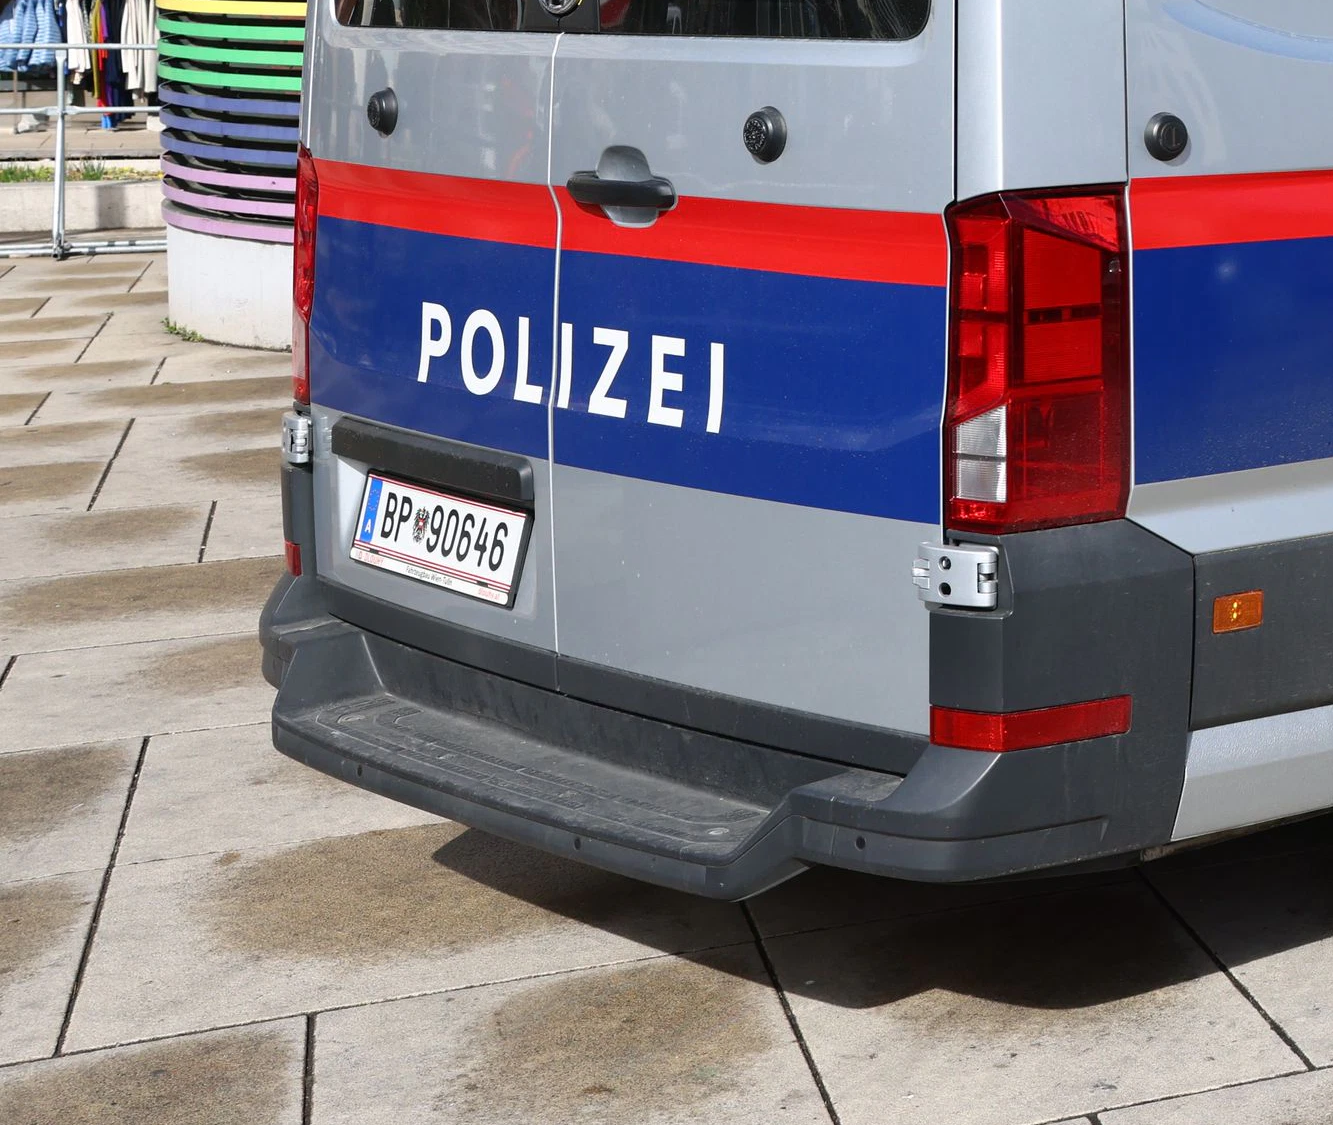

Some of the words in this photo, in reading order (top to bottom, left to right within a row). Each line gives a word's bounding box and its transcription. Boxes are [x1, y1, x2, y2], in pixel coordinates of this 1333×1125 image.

[417, 302, 724, 434] POLIZEI
[365, 519, 372, 533] A
[381, 492, 413, 542] BP
[426, 505, 508, 572] 90646
